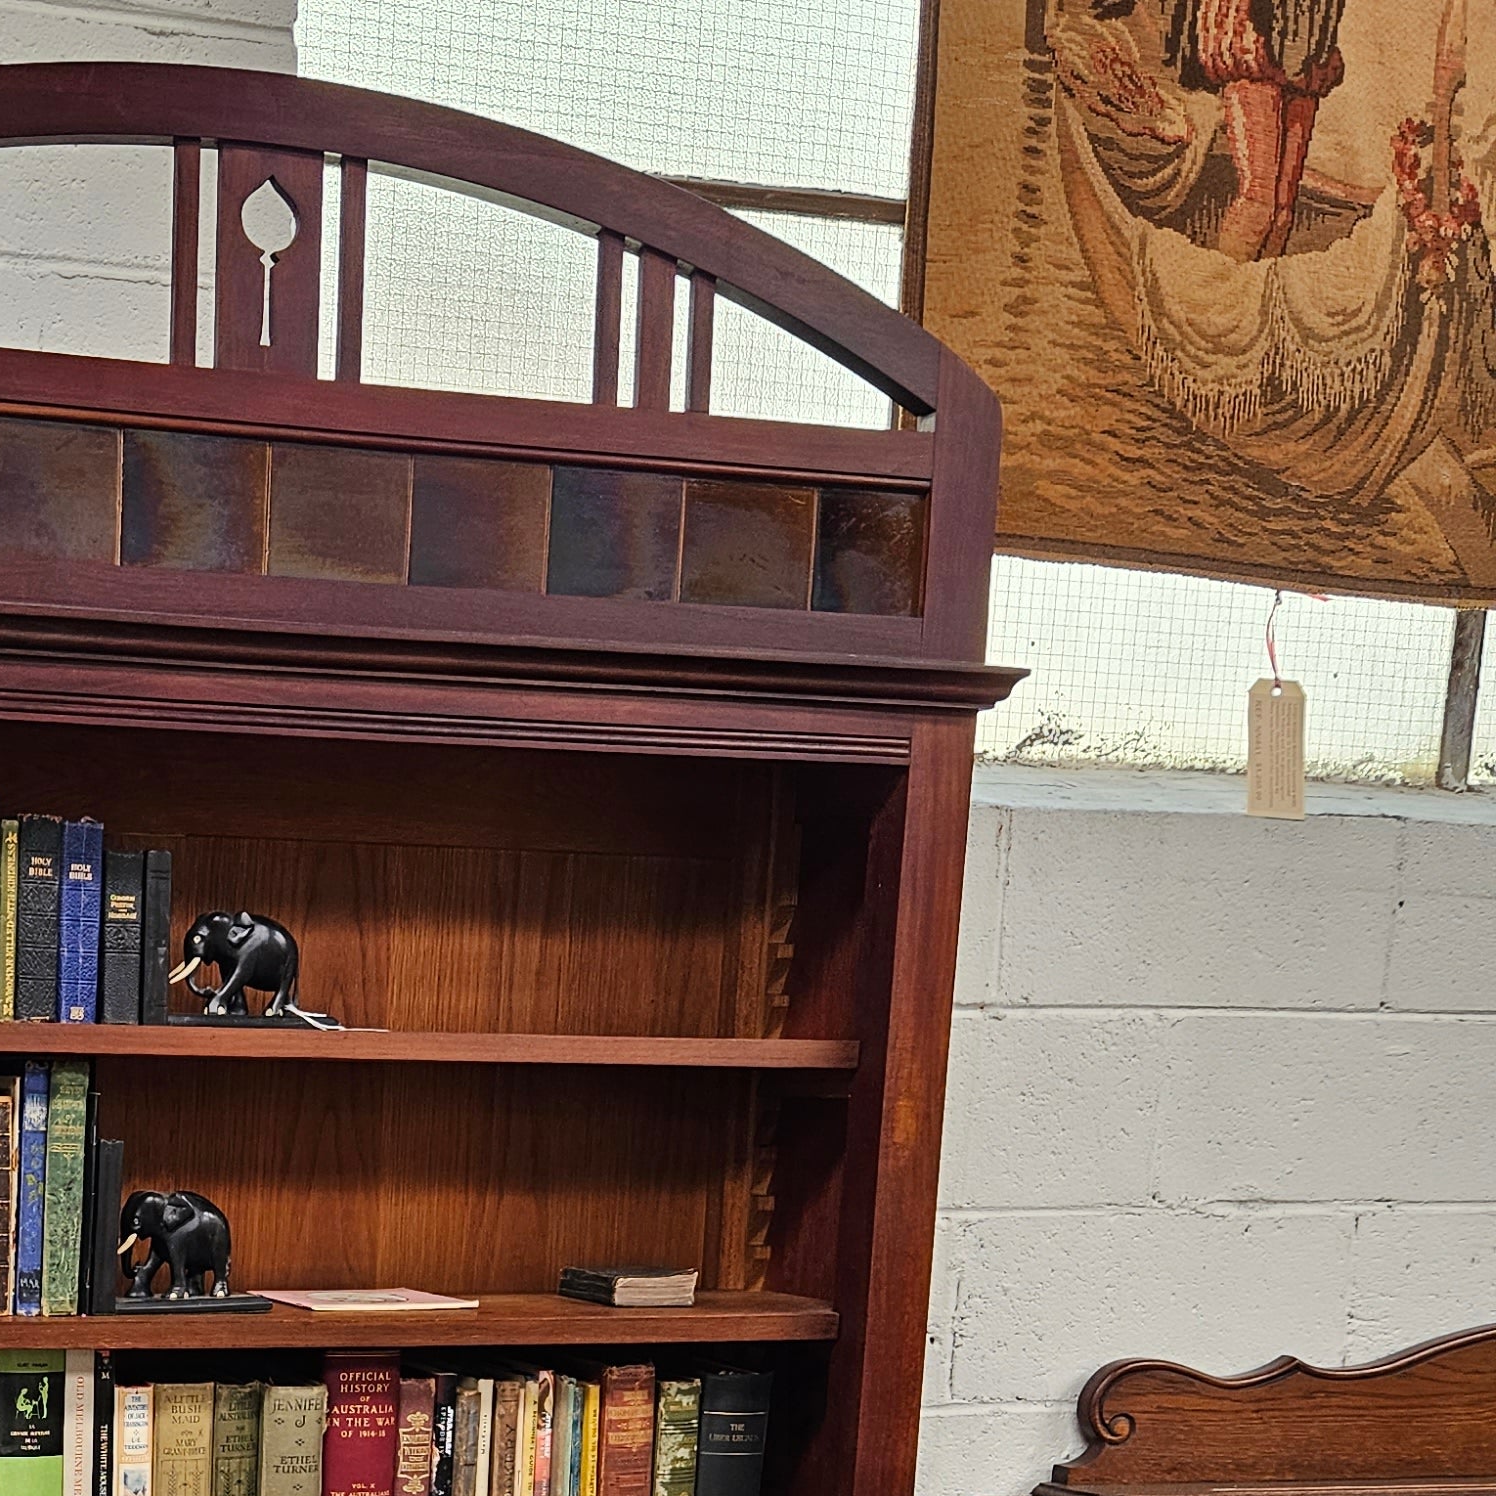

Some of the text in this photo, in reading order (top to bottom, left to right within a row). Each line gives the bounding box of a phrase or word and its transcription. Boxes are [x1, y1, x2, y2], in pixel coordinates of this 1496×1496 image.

[31, 856, 52, 867] HOLY
[29, 867, 53, 877] BIBLE
[339, 1372, 391, 1381] OFFICIAL
[77, 1377, 85, 1400] OLD
[340, 1383, 390, 1393] HISTORY
[75, 1404, 84, 1476] MELBOURNE
